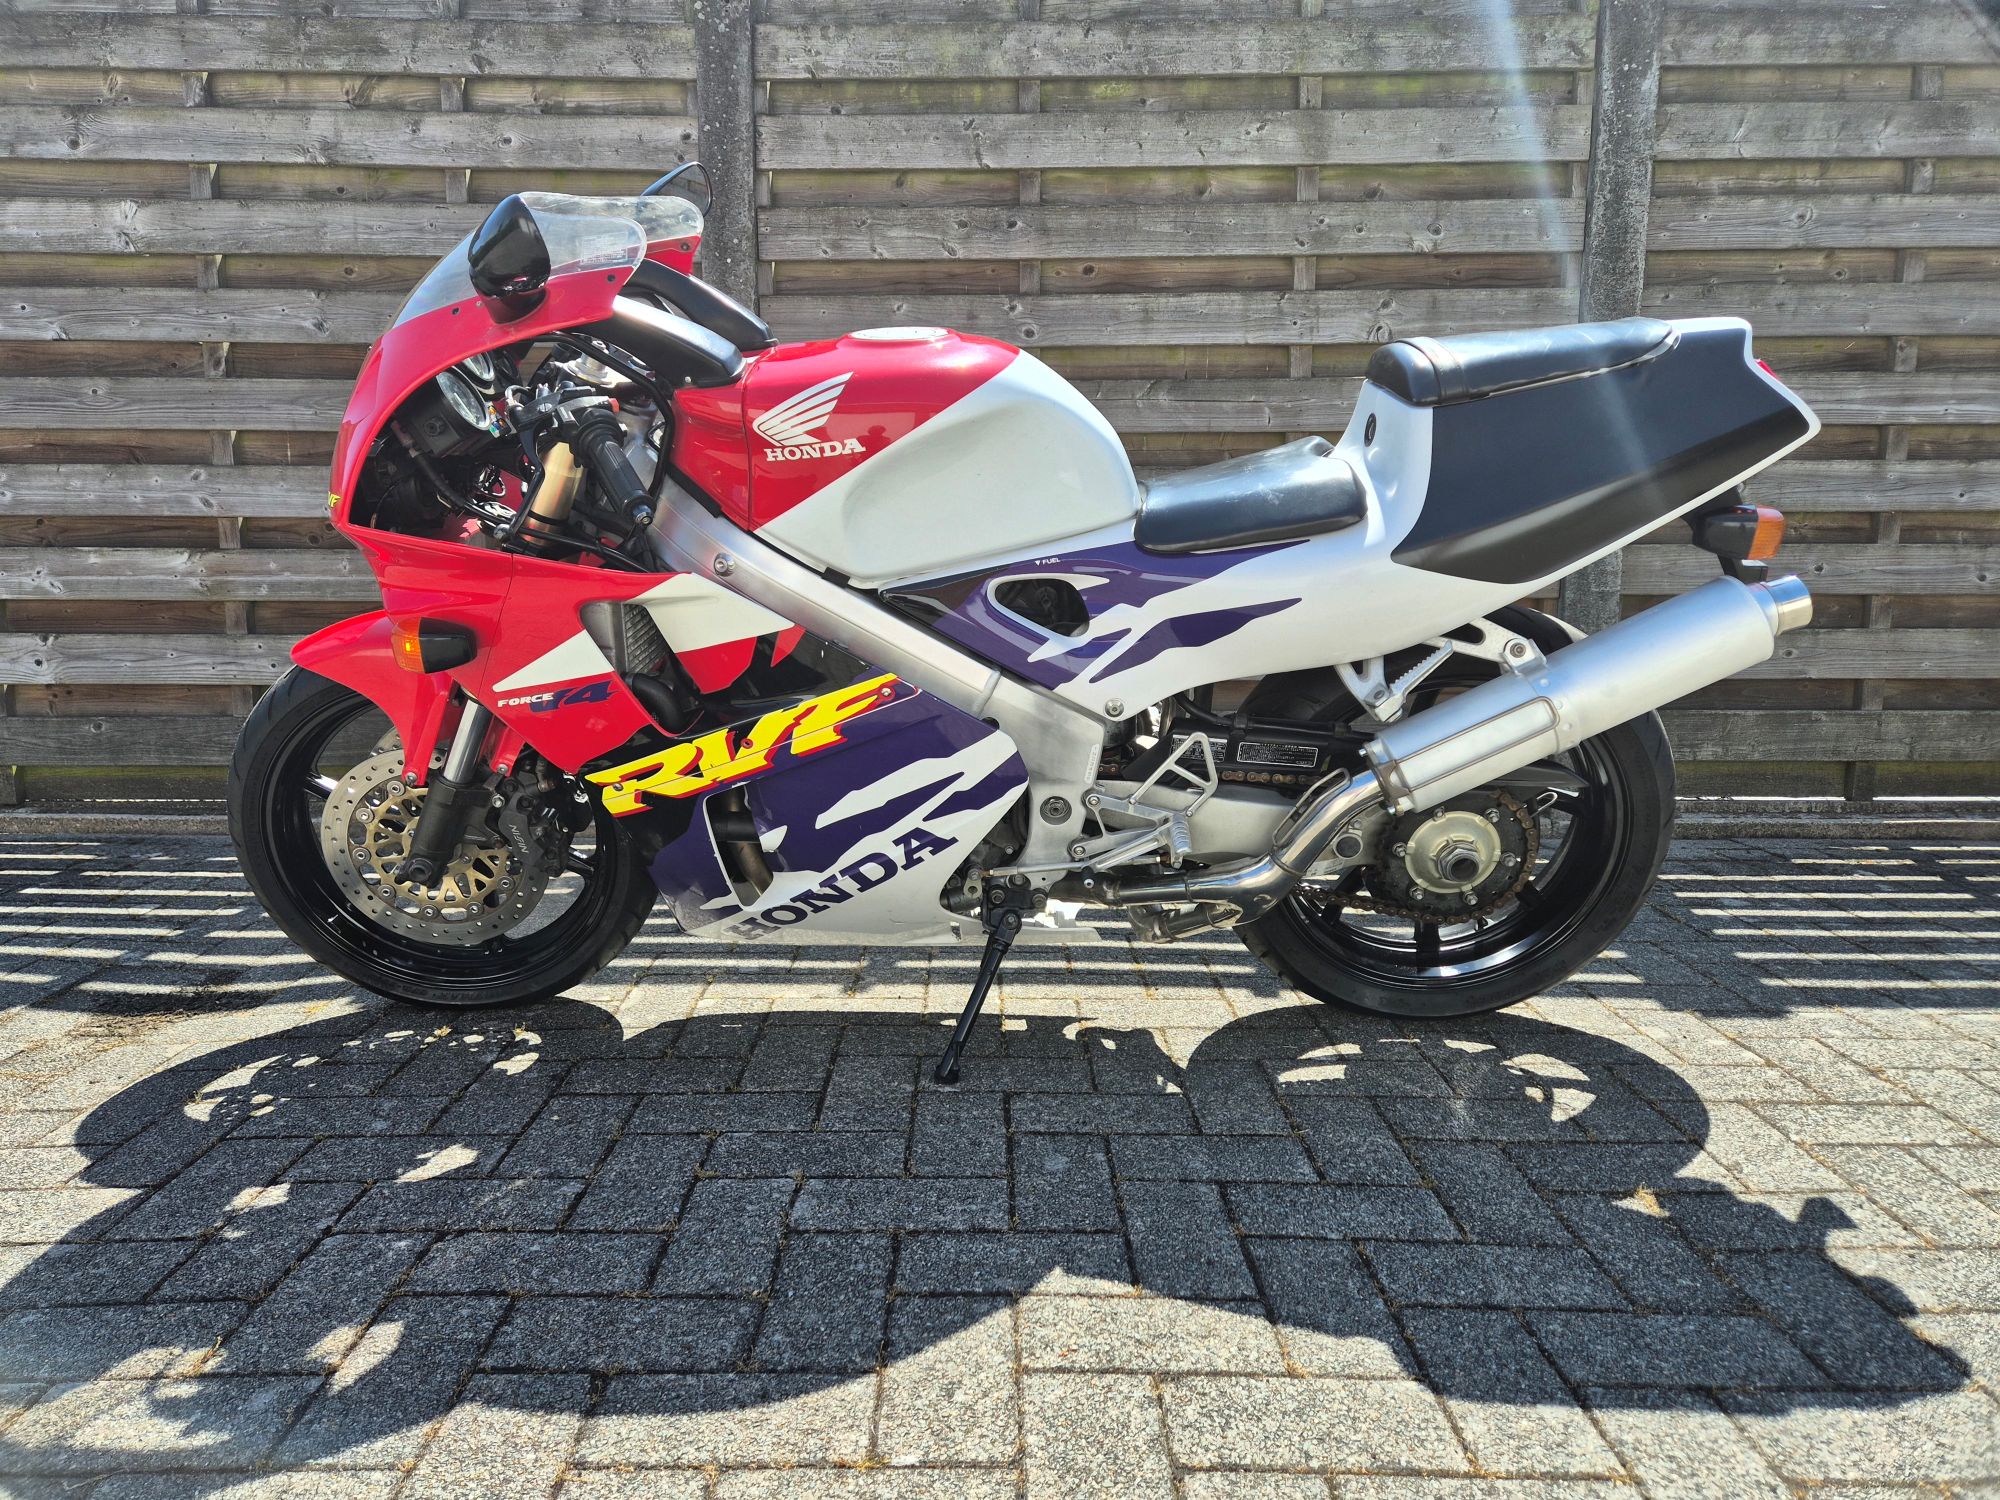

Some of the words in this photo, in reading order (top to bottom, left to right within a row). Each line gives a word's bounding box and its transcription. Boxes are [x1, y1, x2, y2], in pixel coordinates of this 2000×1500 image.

[763, 437, 867, 462] HONDA
[1042, 557, 1062, 565] FUEL
[497, 692, 555, 708] FORCE
[584, 672, 900, 818] RVF
[723, 826, 960, 941] HONDA
